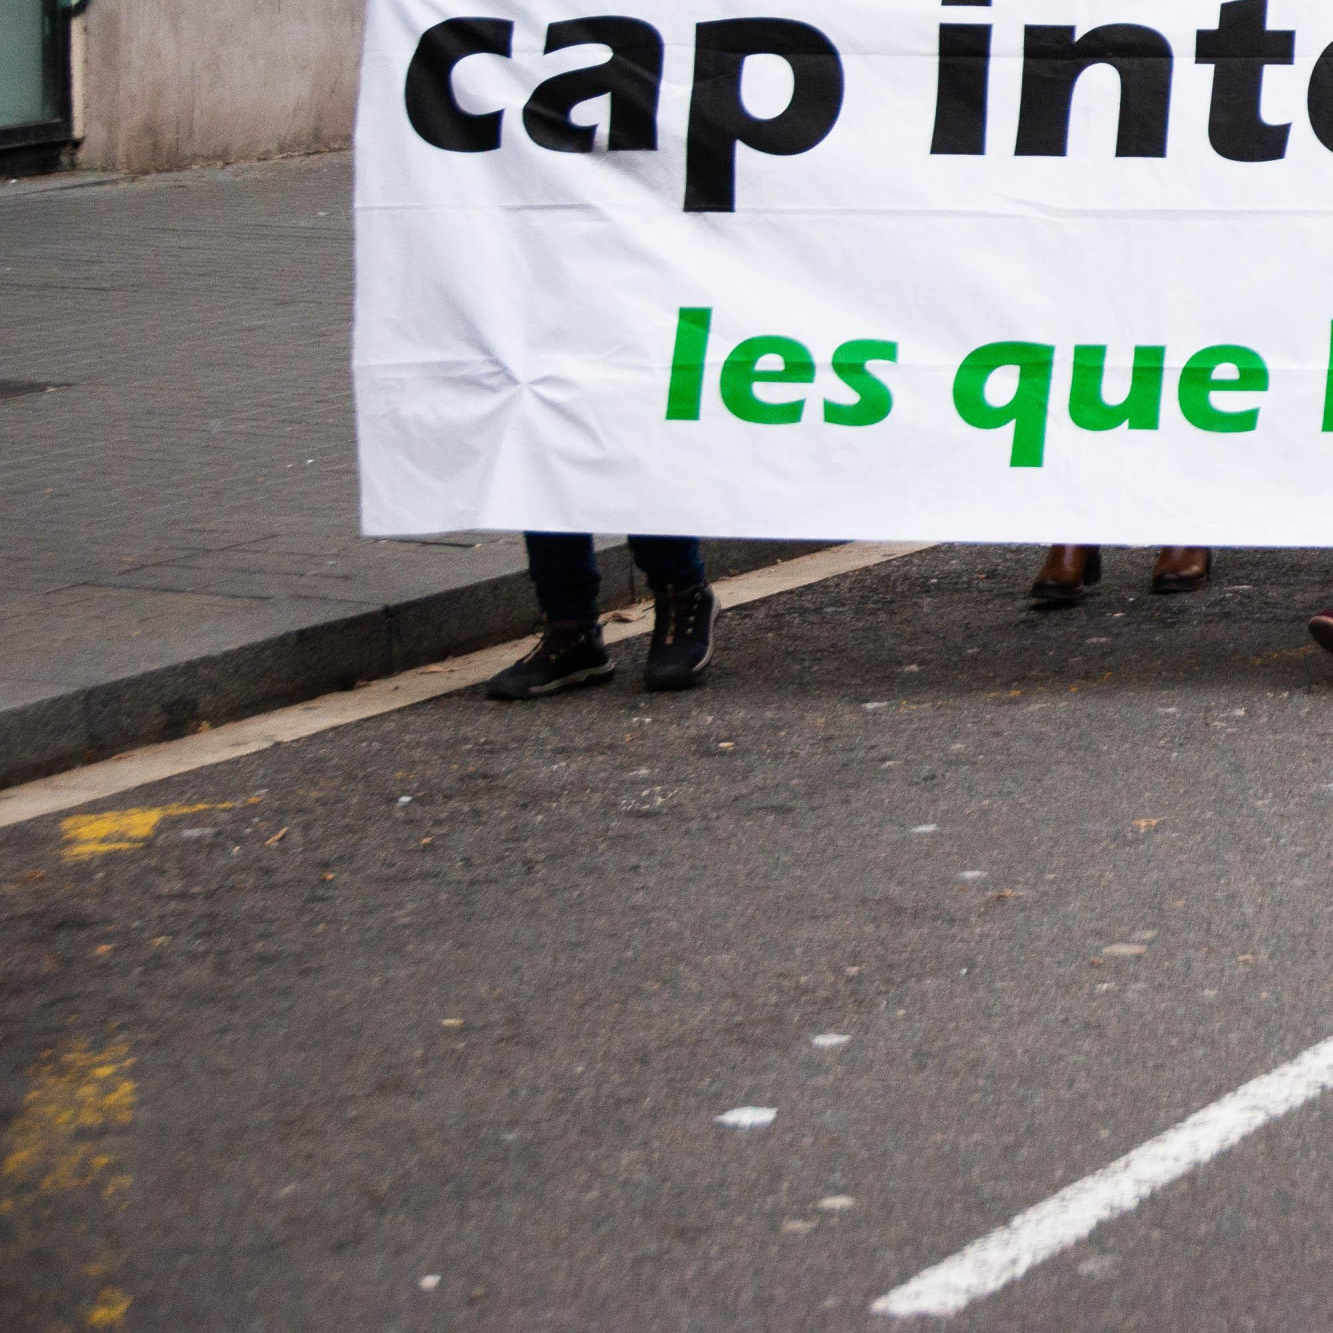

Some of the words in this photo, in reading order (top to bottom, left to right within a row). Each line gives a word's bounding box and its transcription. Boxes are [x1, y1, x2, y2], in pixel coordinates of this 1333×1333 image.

[405, 16, 842, 213] cap
[665, 307, 898, 427] les
[952, 339, 1270, 468] que
